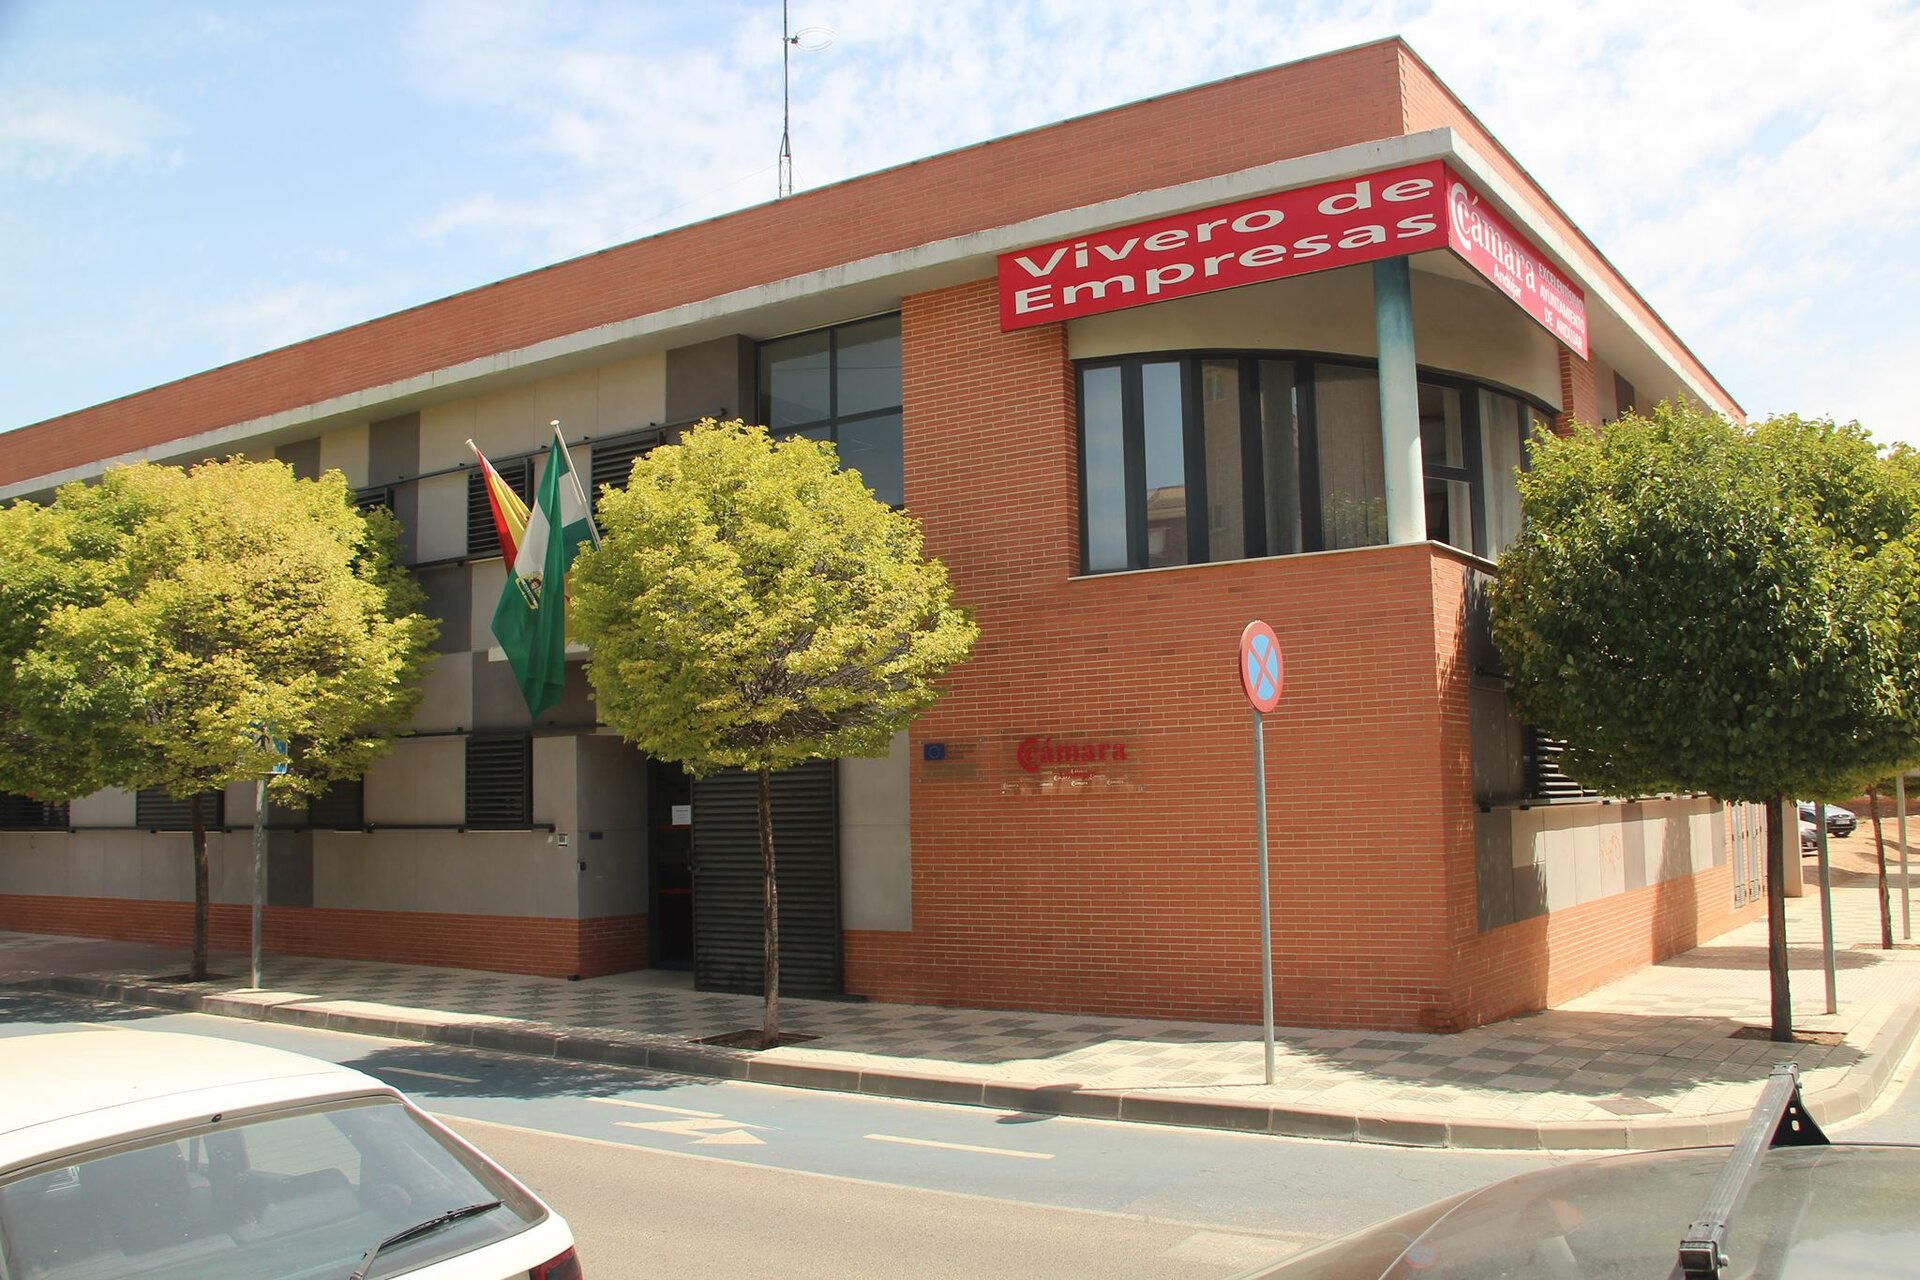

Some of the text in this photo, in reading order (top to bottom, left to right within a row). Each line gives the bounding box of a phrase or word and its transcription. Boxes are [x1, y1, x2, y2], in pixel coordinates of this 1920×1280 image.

[1014, 178, 1434, 278] Vivero de
[1014, 213, 1437, 315] Empresas
[1450, 182, 1537, 293] Cámara
[1540, 284, 1585, 334] AYUNTAMIENTO
[1544, 307, 1554, 328] DE
[1016, 737, 1128, 773] Cámara
